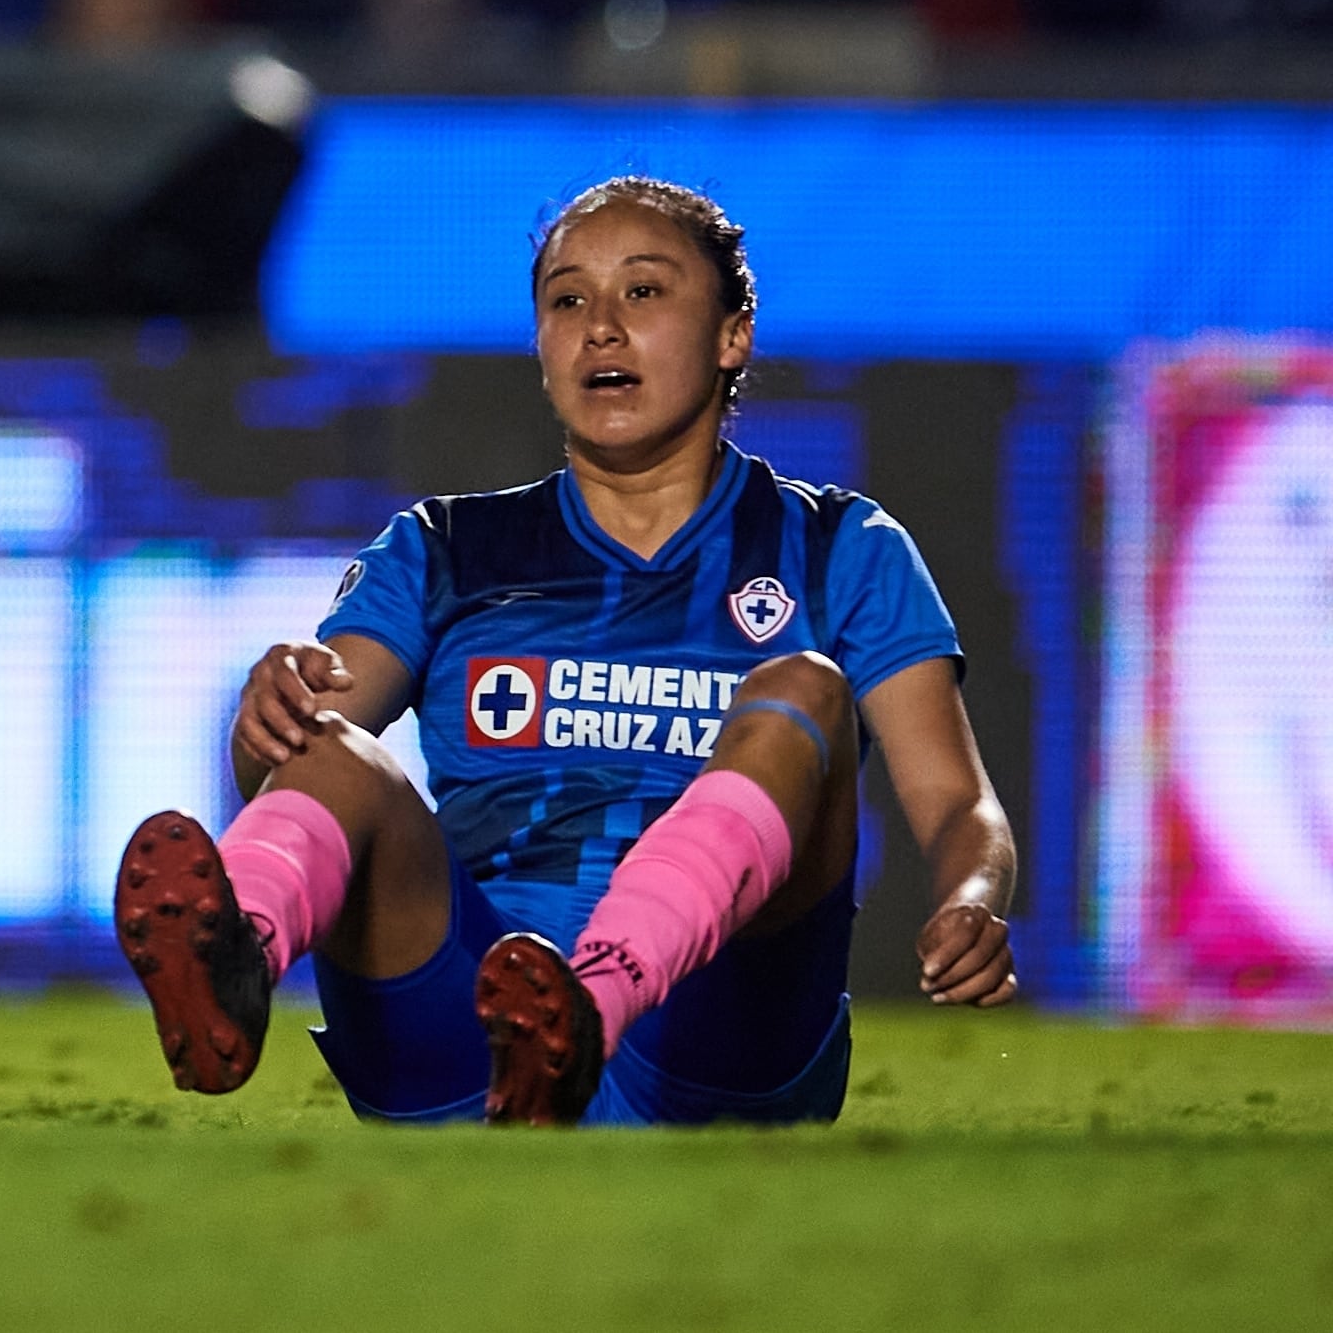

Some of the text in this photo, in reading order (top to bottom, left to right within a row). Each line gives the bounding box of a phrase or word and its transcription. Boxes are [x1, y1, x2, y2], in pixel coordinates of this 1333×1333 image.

[548, 659, 749, 711] CEMENT
[544, 707, 723, 758] CRUZ AZ
